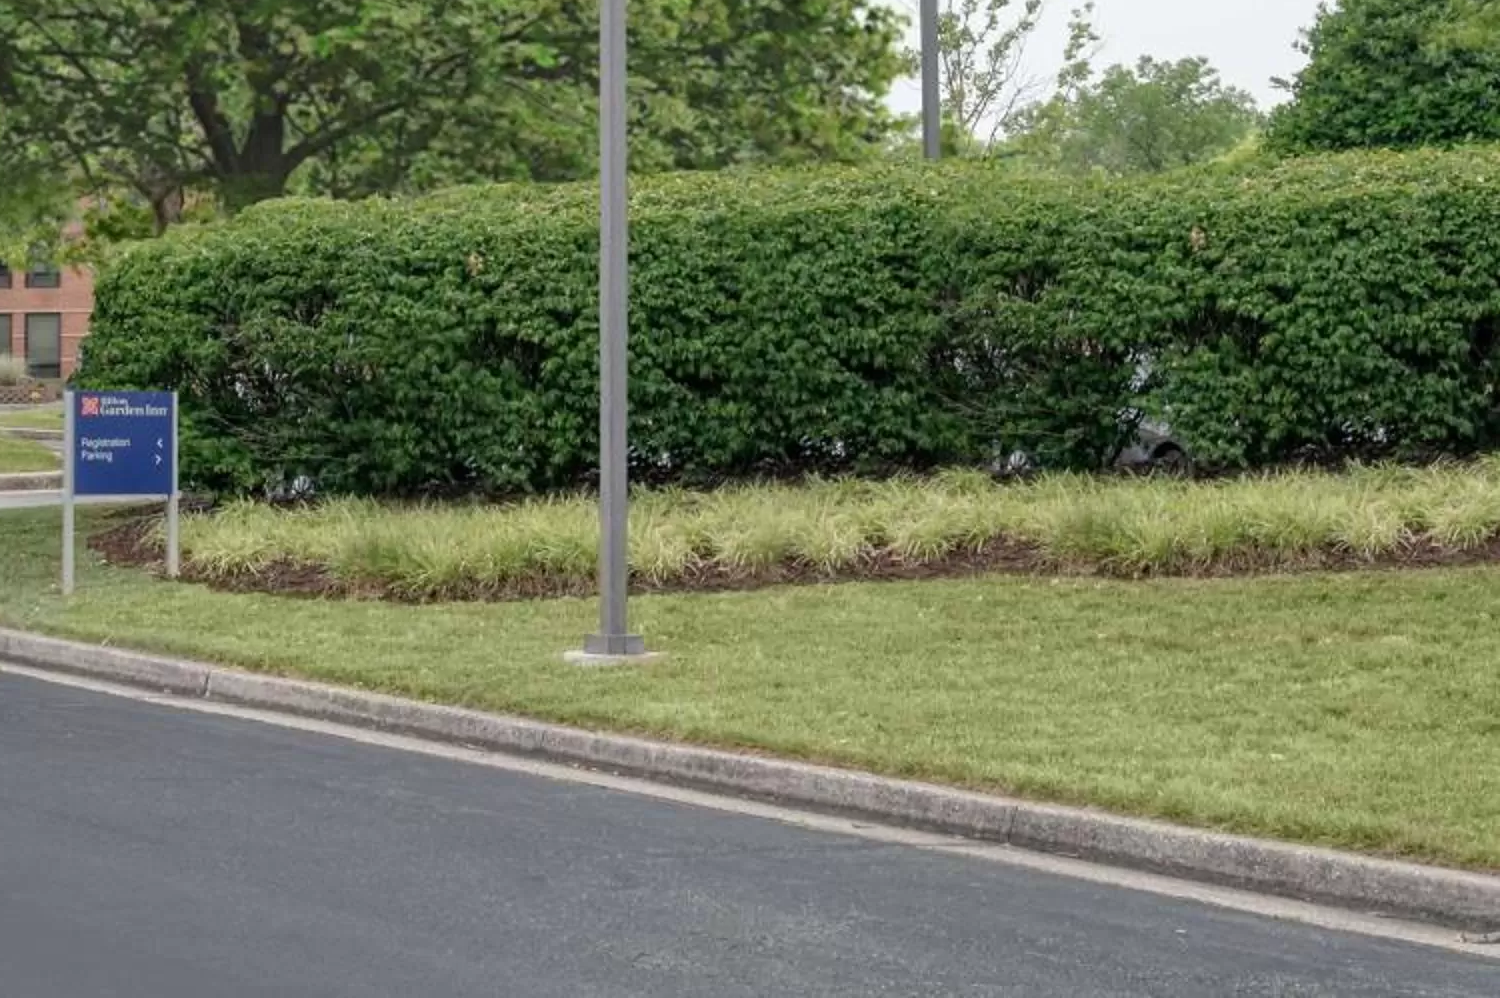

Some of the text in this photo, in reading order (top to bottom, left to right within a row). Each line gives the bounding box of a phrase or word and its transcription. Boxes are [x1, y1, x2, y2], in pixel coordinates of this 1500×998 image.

[100, 396, 128, 404] Hilton
[100, 404, 168, 416] Garden Inn
[81, 438, 131, 448] Registration
[81, 450, 113, 462] Parking
